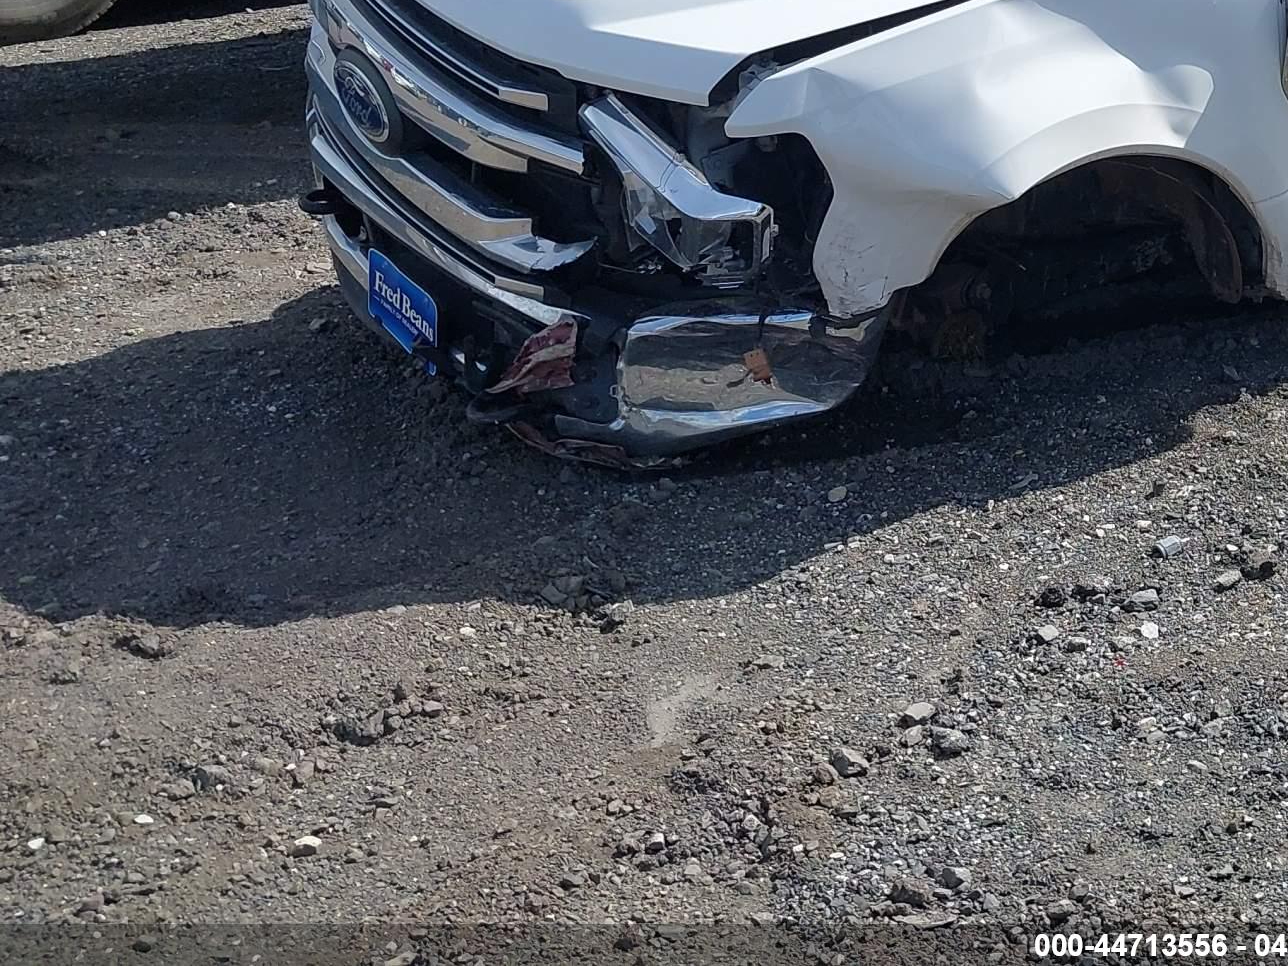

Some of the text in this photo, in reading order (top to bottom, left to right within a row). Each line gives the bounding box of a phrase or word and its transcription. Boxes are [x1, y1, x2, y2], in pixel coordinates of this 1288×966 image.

[341, 76, 372, 124] Ford
[374, 270, 434, 342] Fred Beans
